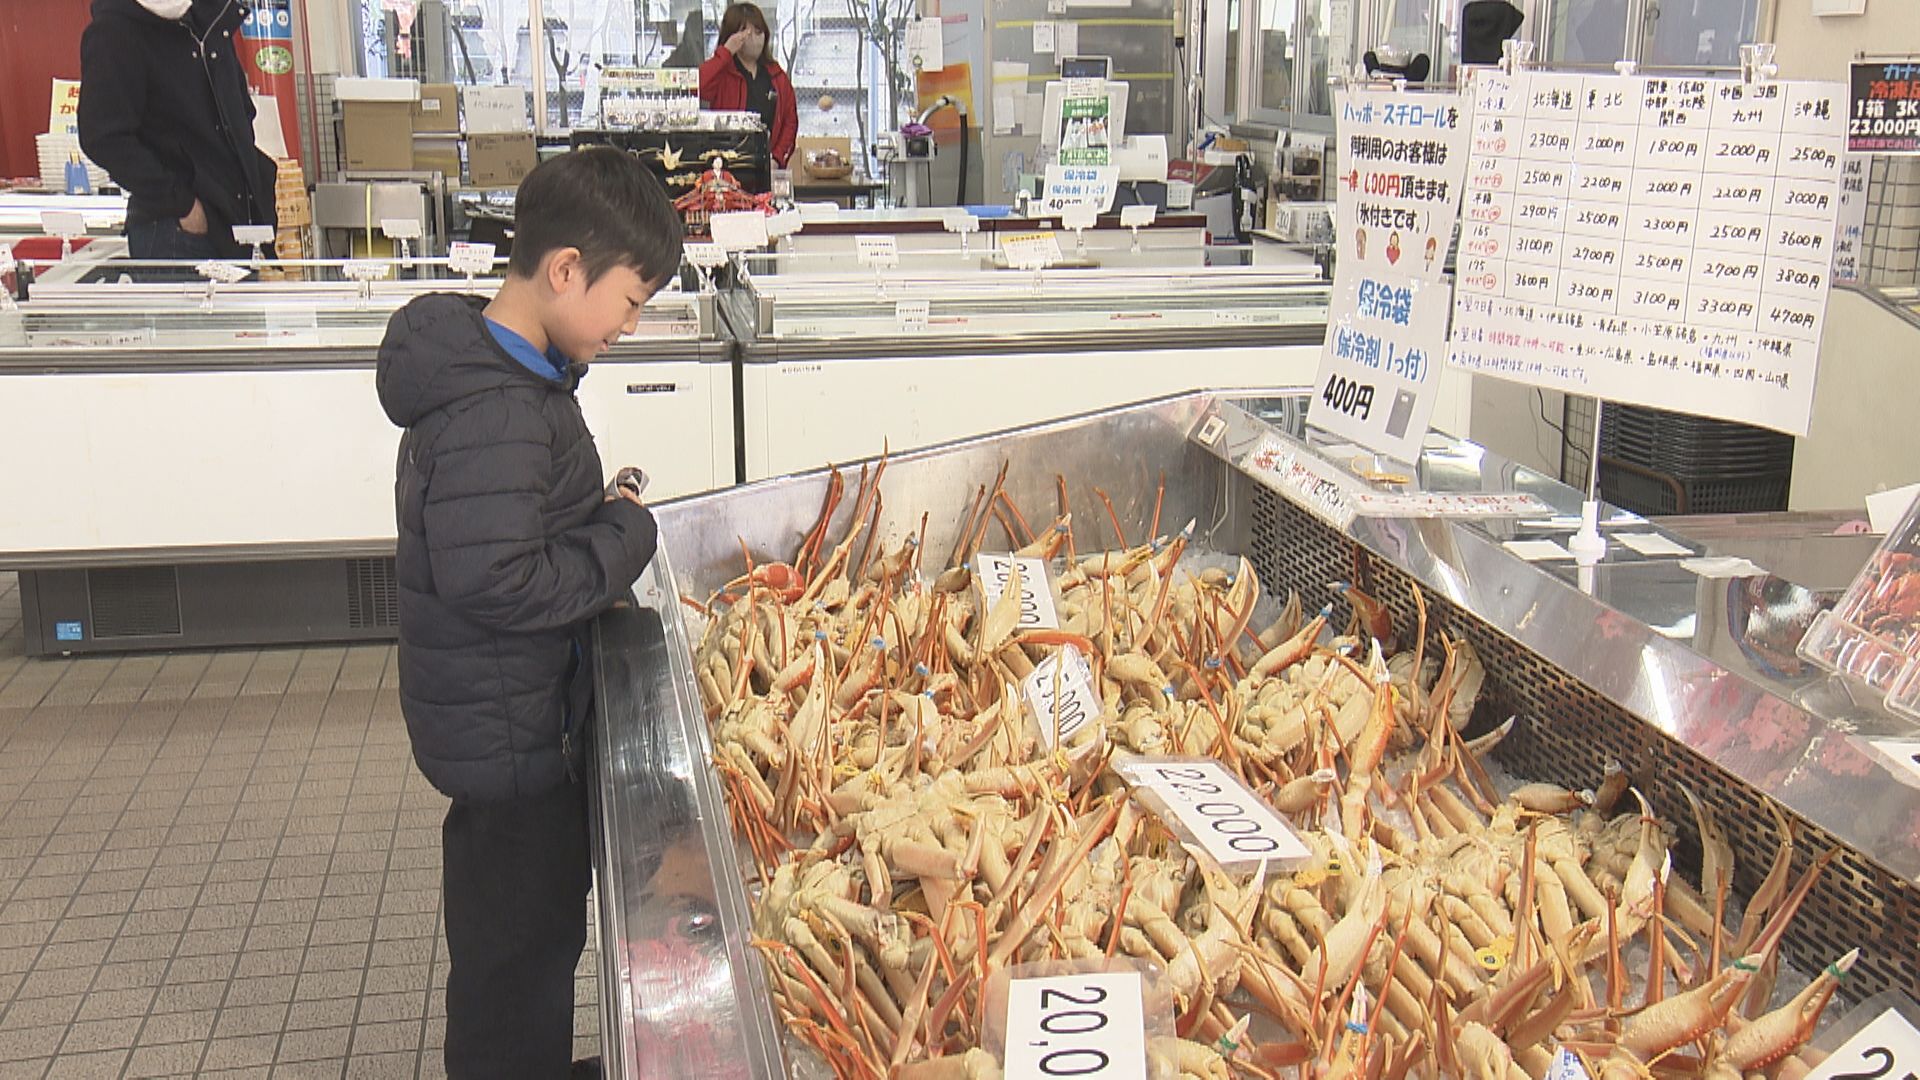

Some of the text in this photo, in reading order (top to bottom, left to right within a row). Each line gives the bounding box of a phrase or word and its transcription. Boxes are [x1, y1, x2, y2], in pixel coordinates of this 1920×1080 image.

[1532, 89, 1573, 110] 北海道
[1794, 99, 1830, 120] 沖縄
[1529, 133, 1836, 169] 2300円 2000円 1800円 2000円 2500円
[1522, 170, 1829, 211] 2500円 2200円 2000円 2200円 3000円
[1520, 205, 1559, 220] 2900円
[1576, 210, 1619, 227] 2500円
[1643, 218, 1688, 234] 2300円
[1709, 225, 1761, 242] 2500円
[1778, 230, 1822, 249] 3600円
[1516, 237, 1820, 290] 3100円 2700円 2500円 2700円 3800円
[1358, 278, 1412, 326] 保冷袋
[1515, 273, 1815, 329] 3600円 3300円 3100円 3300円 4700円
[1323, 373, 1375, 421] 400円
